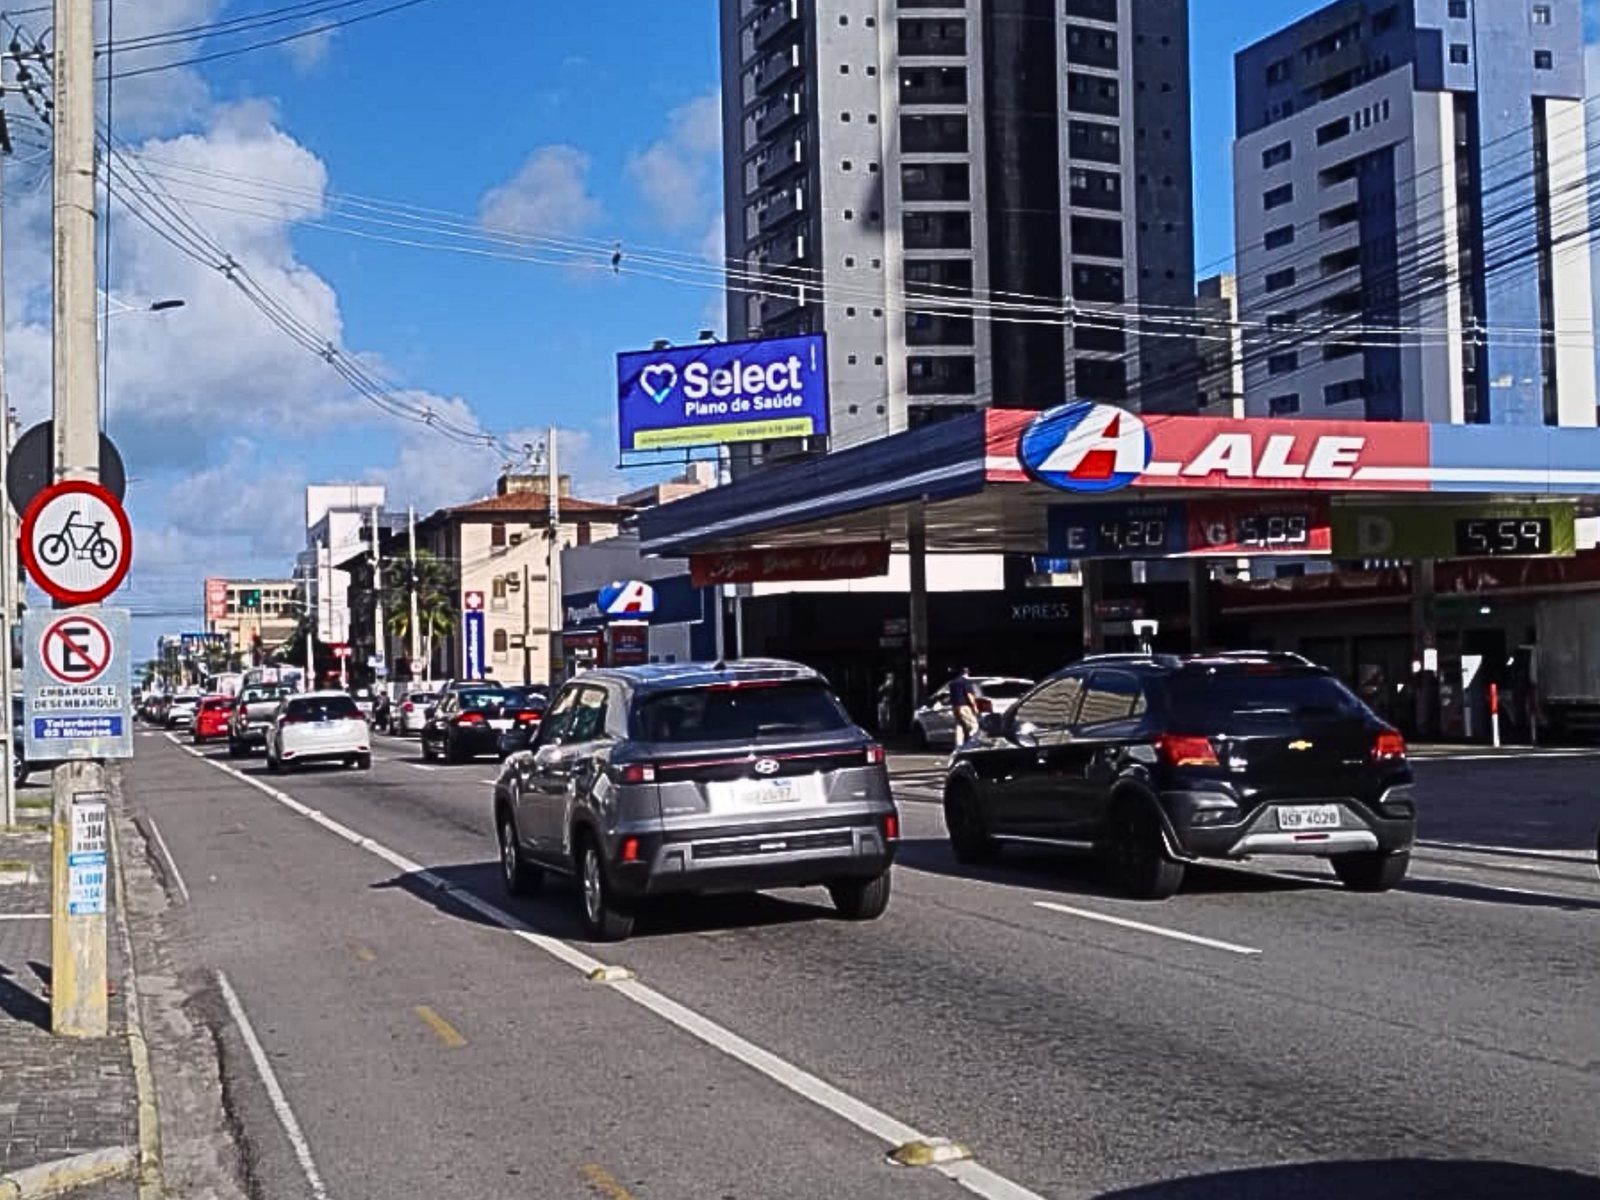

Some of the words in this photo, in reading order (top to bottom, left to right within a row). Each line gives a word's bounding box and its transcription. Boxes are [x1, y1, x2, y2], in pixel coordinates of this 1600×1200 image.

[683, 354, 804, 399] Select
[685, 400, 728, 418] Plano
[731, 399, 751, 413] de
[753, 393, 803, 411] Saúde
[1182, 433, 1366, 480] ALE
[1066, 527, 1086, 549] E
[1100, 519, 1165, 550] 4,20
[1206, 523, 1228, 545] G
[1356, 514, 1394, 552] D
[1467, 520, 1542, 554] 5,59
[1010, 602, 1070, 619] XPRESS
[63, 628, 91, 672] E
